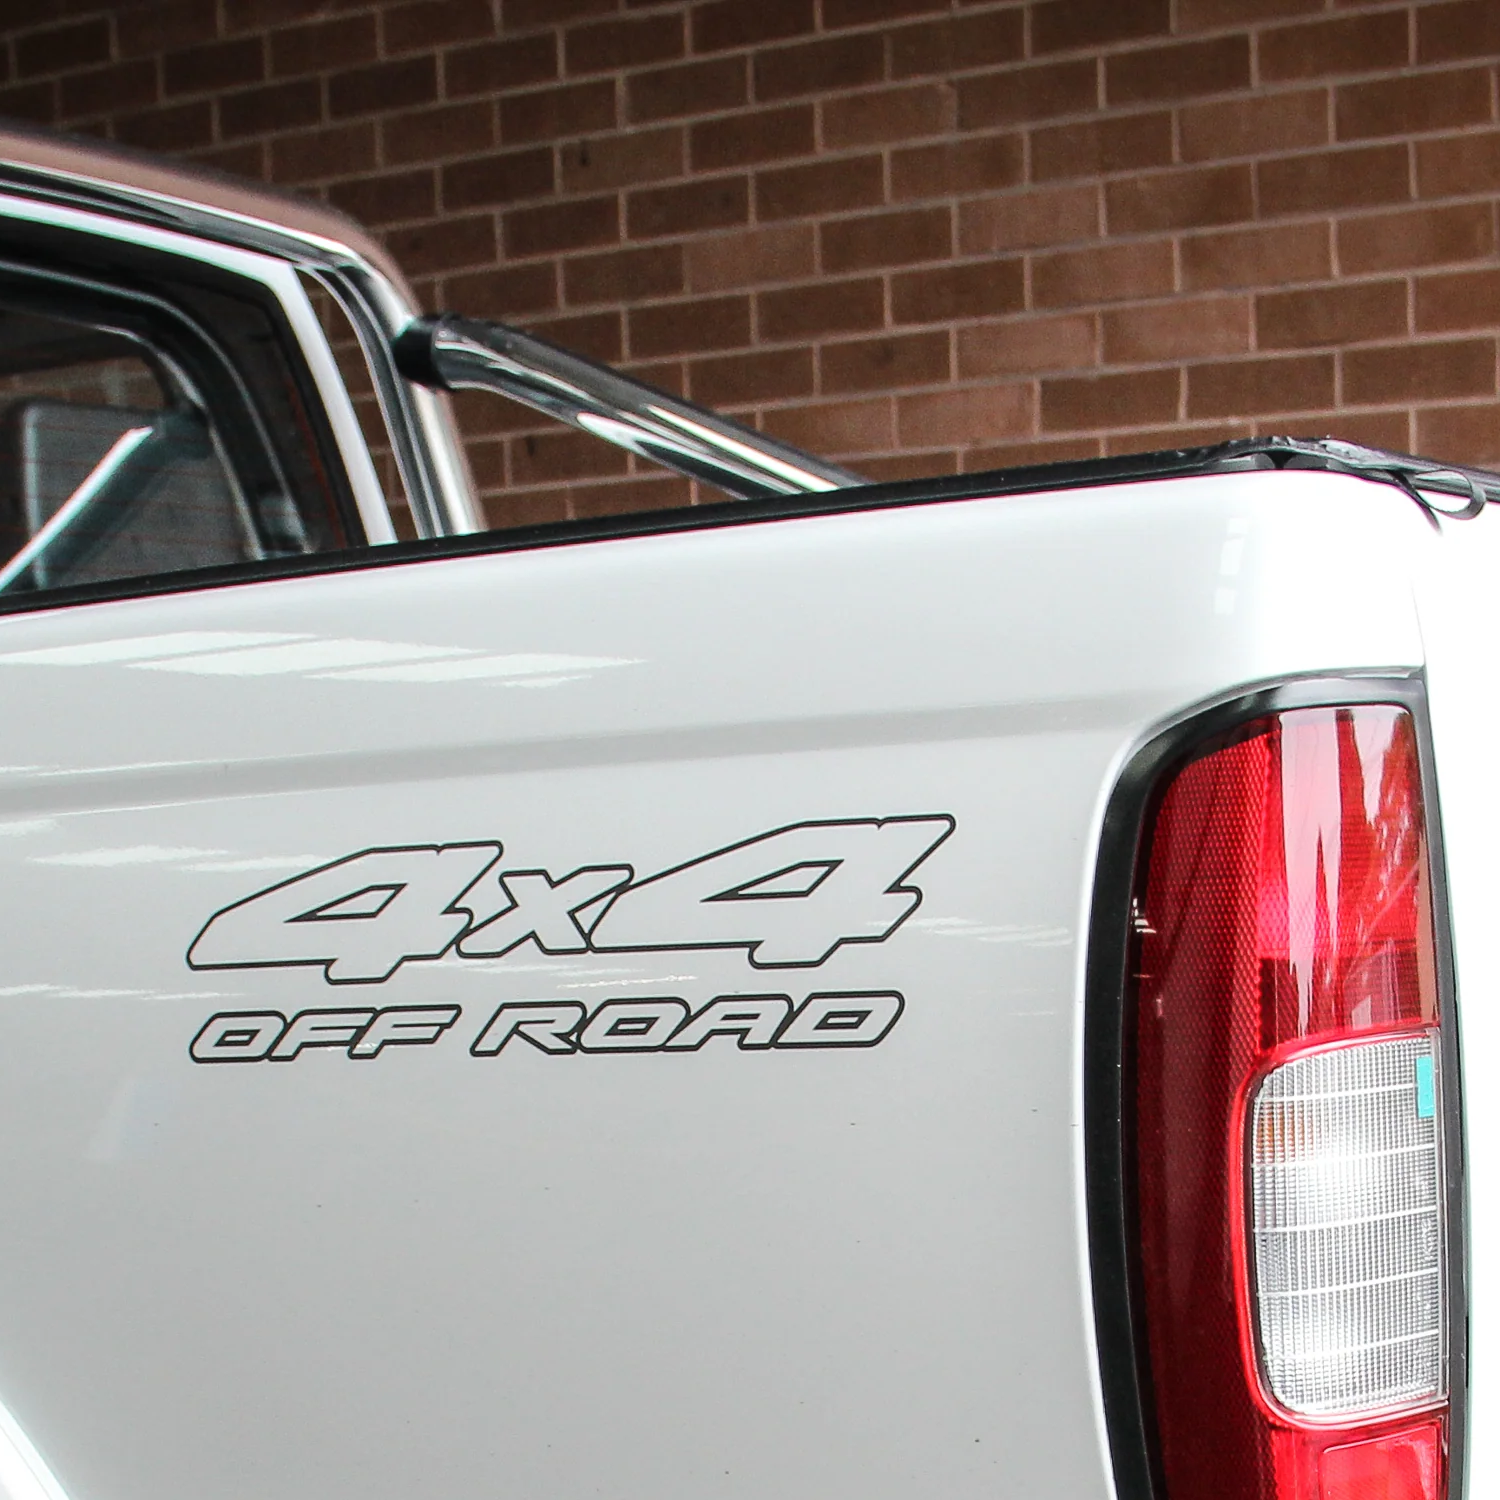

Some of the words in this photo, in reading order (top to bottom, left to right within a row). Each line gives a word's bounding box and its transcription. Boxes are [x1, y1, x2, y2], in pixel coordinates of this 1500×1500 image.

[186, 812, 957, 985] 4x4
[189, 1003, 462, 1064] OFF
[469, 989, 906, 1057] ROAD
